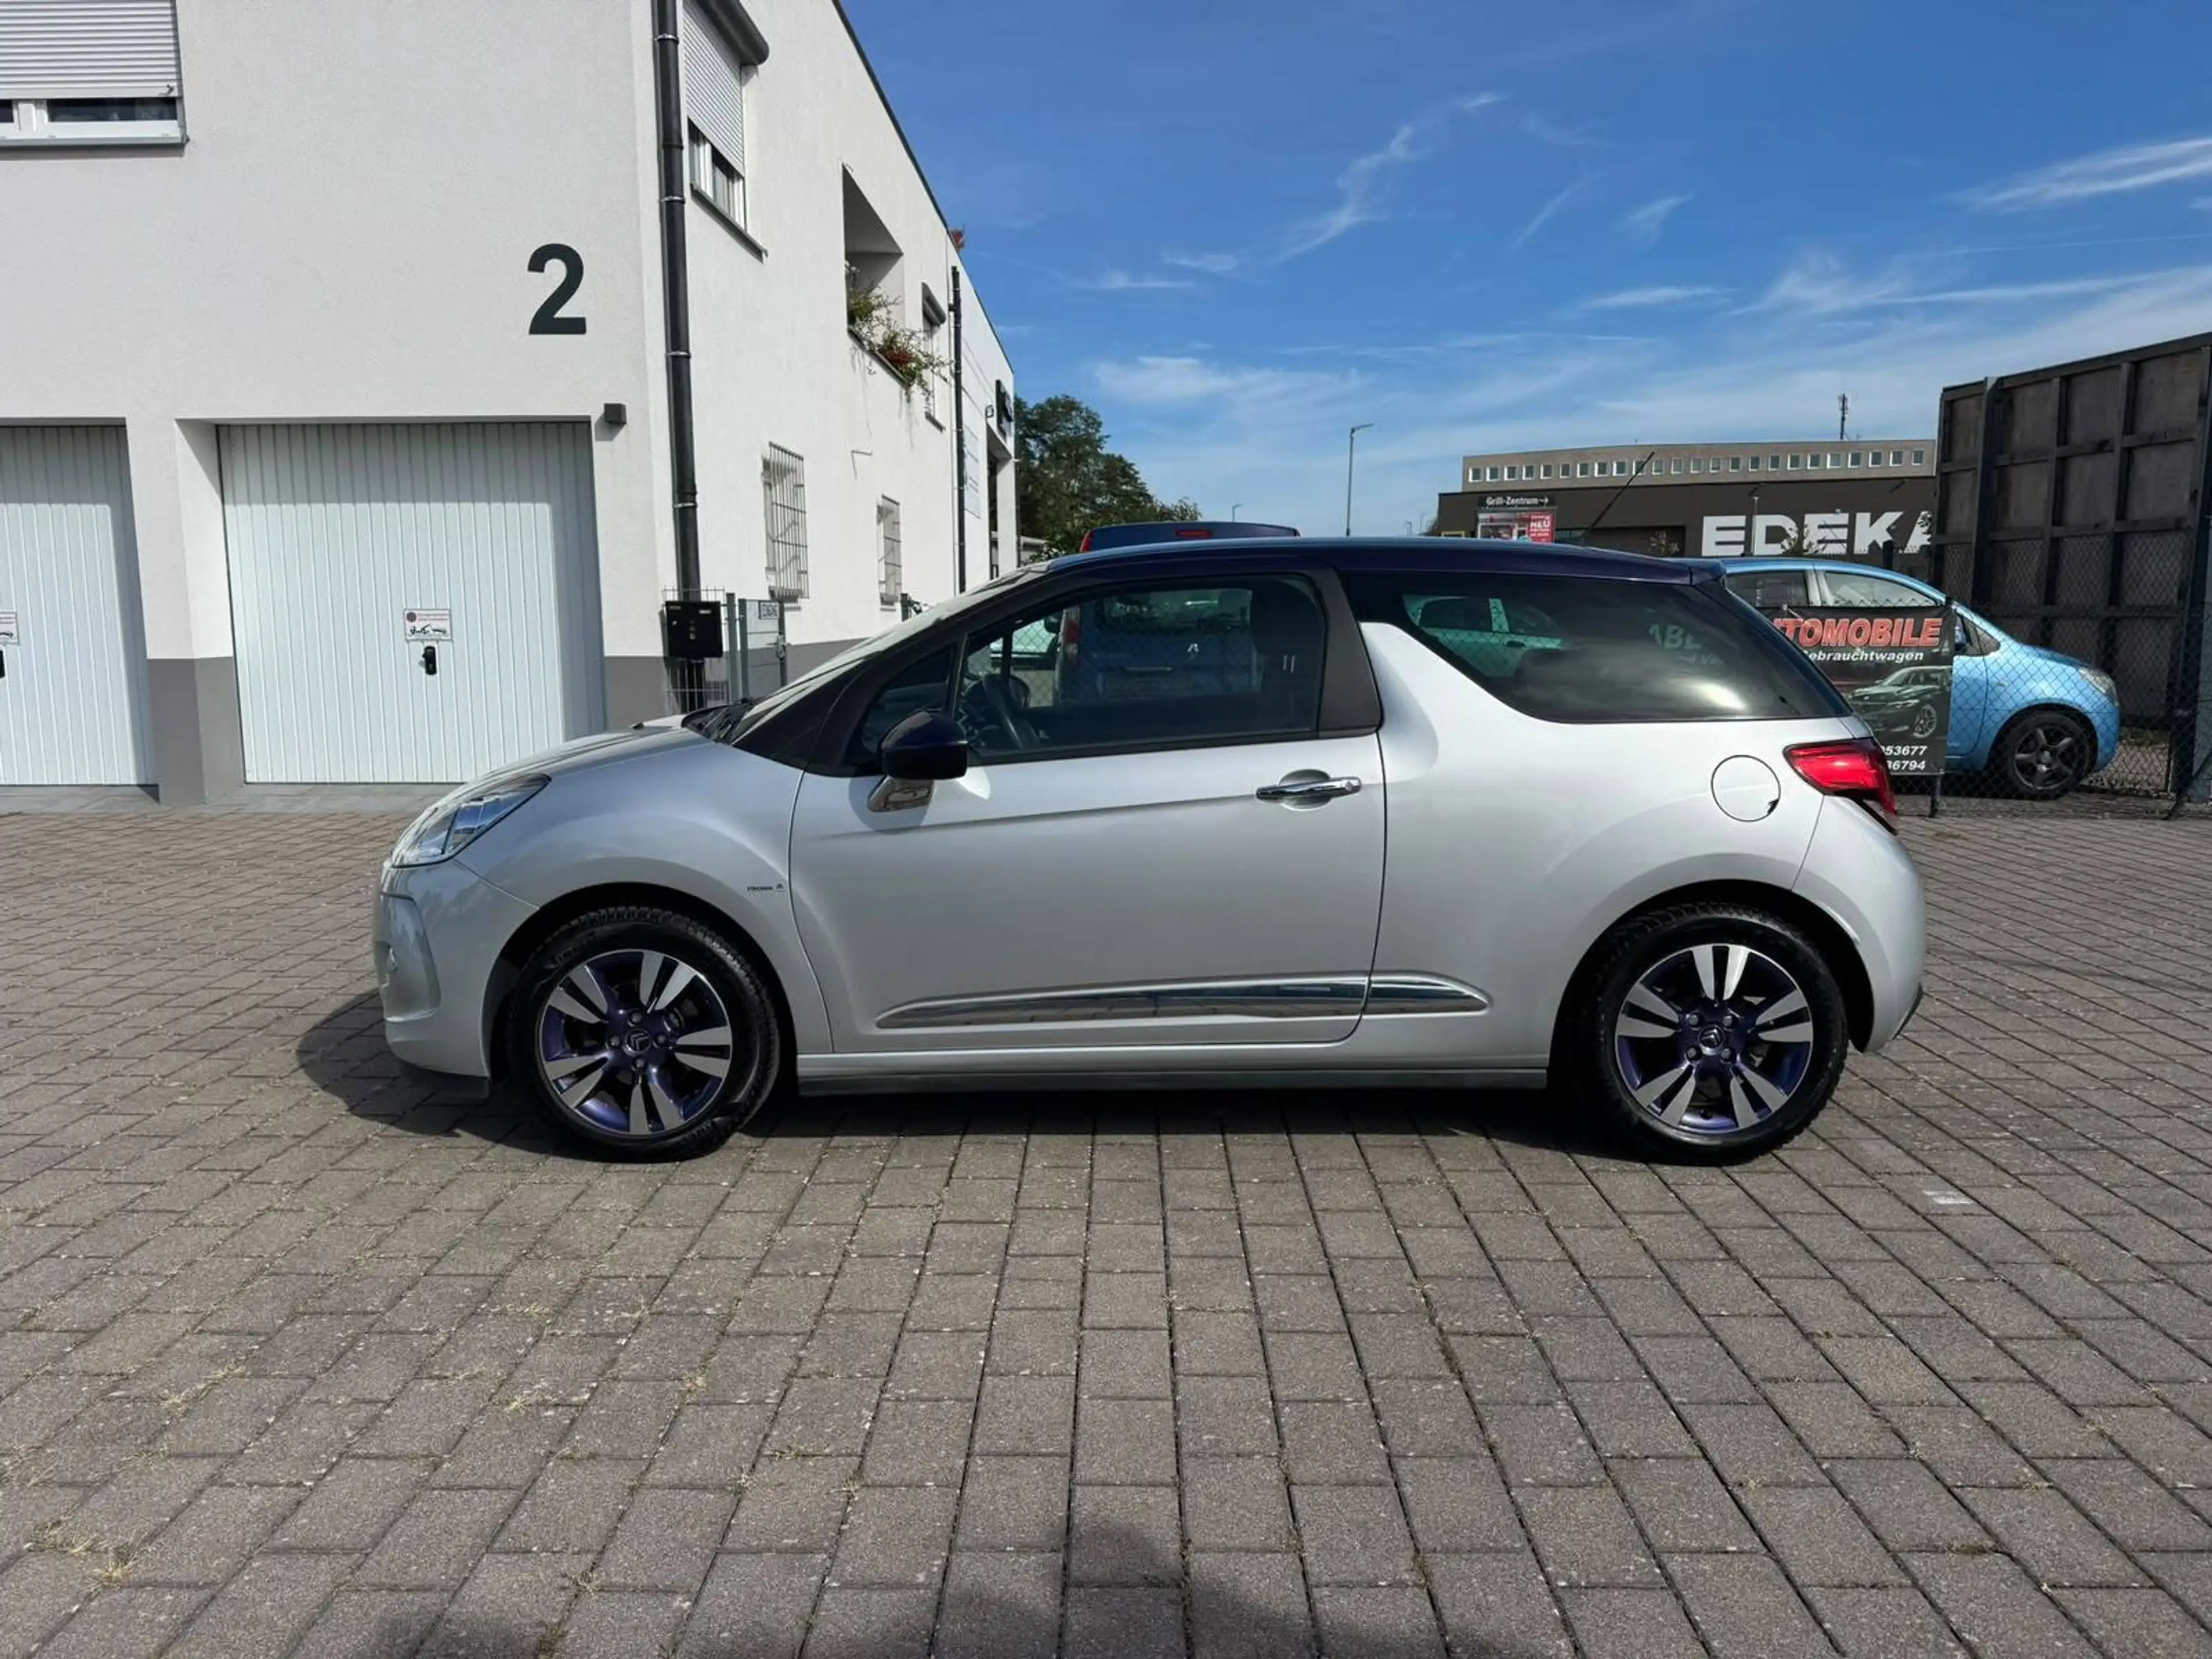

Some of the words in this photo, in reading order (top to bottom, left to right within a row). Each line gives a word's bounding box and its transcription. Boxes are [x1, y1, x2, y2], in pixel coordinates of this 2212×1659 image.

[528, 243, 586, 335] 2
[1774, 618, 1943, 647] TOMOBILE
[1803, 649, 1924, 663] ebrauchtwagen
